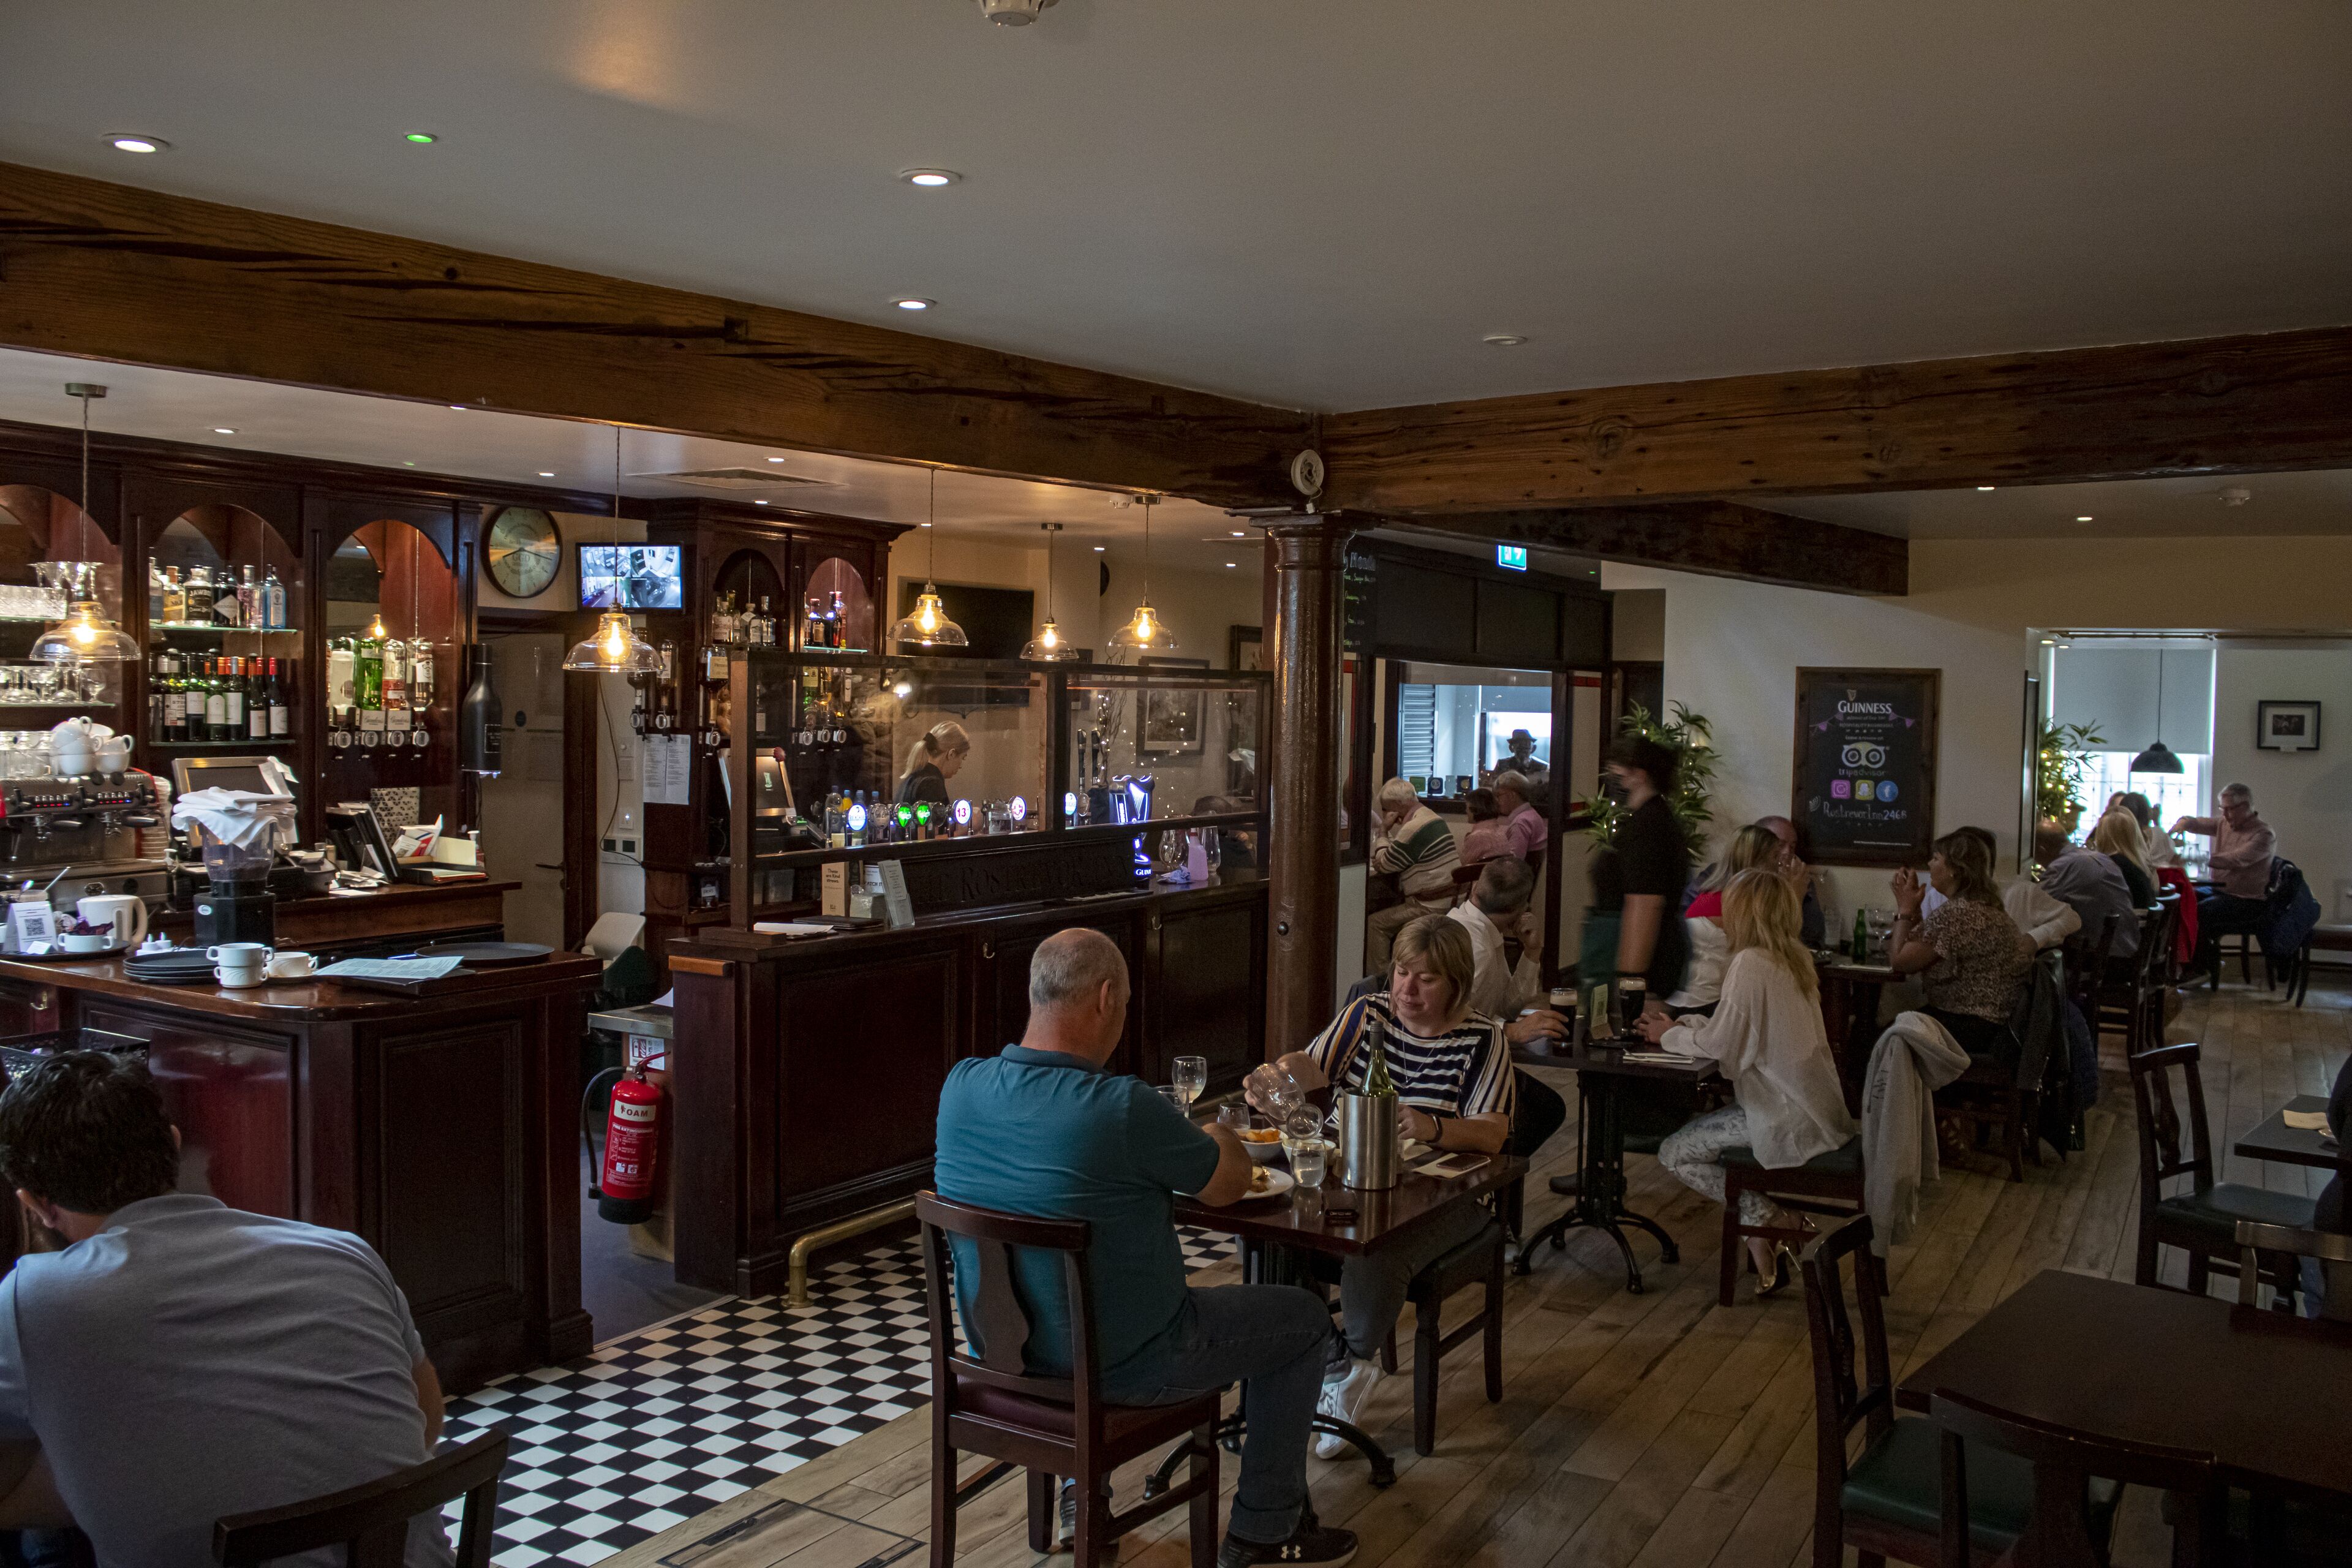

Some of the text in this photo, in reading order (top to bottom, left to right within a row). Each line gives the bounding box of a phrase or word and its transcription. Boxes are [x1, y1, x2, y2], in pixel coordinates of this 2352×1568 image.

[1838, 701, 1892, 714] GUINNESS
[1839, 768, 1886, 777] tripadvisor
[957, 808, 966, 817] 13
[620, 1104, 647, 1117] FOAM
